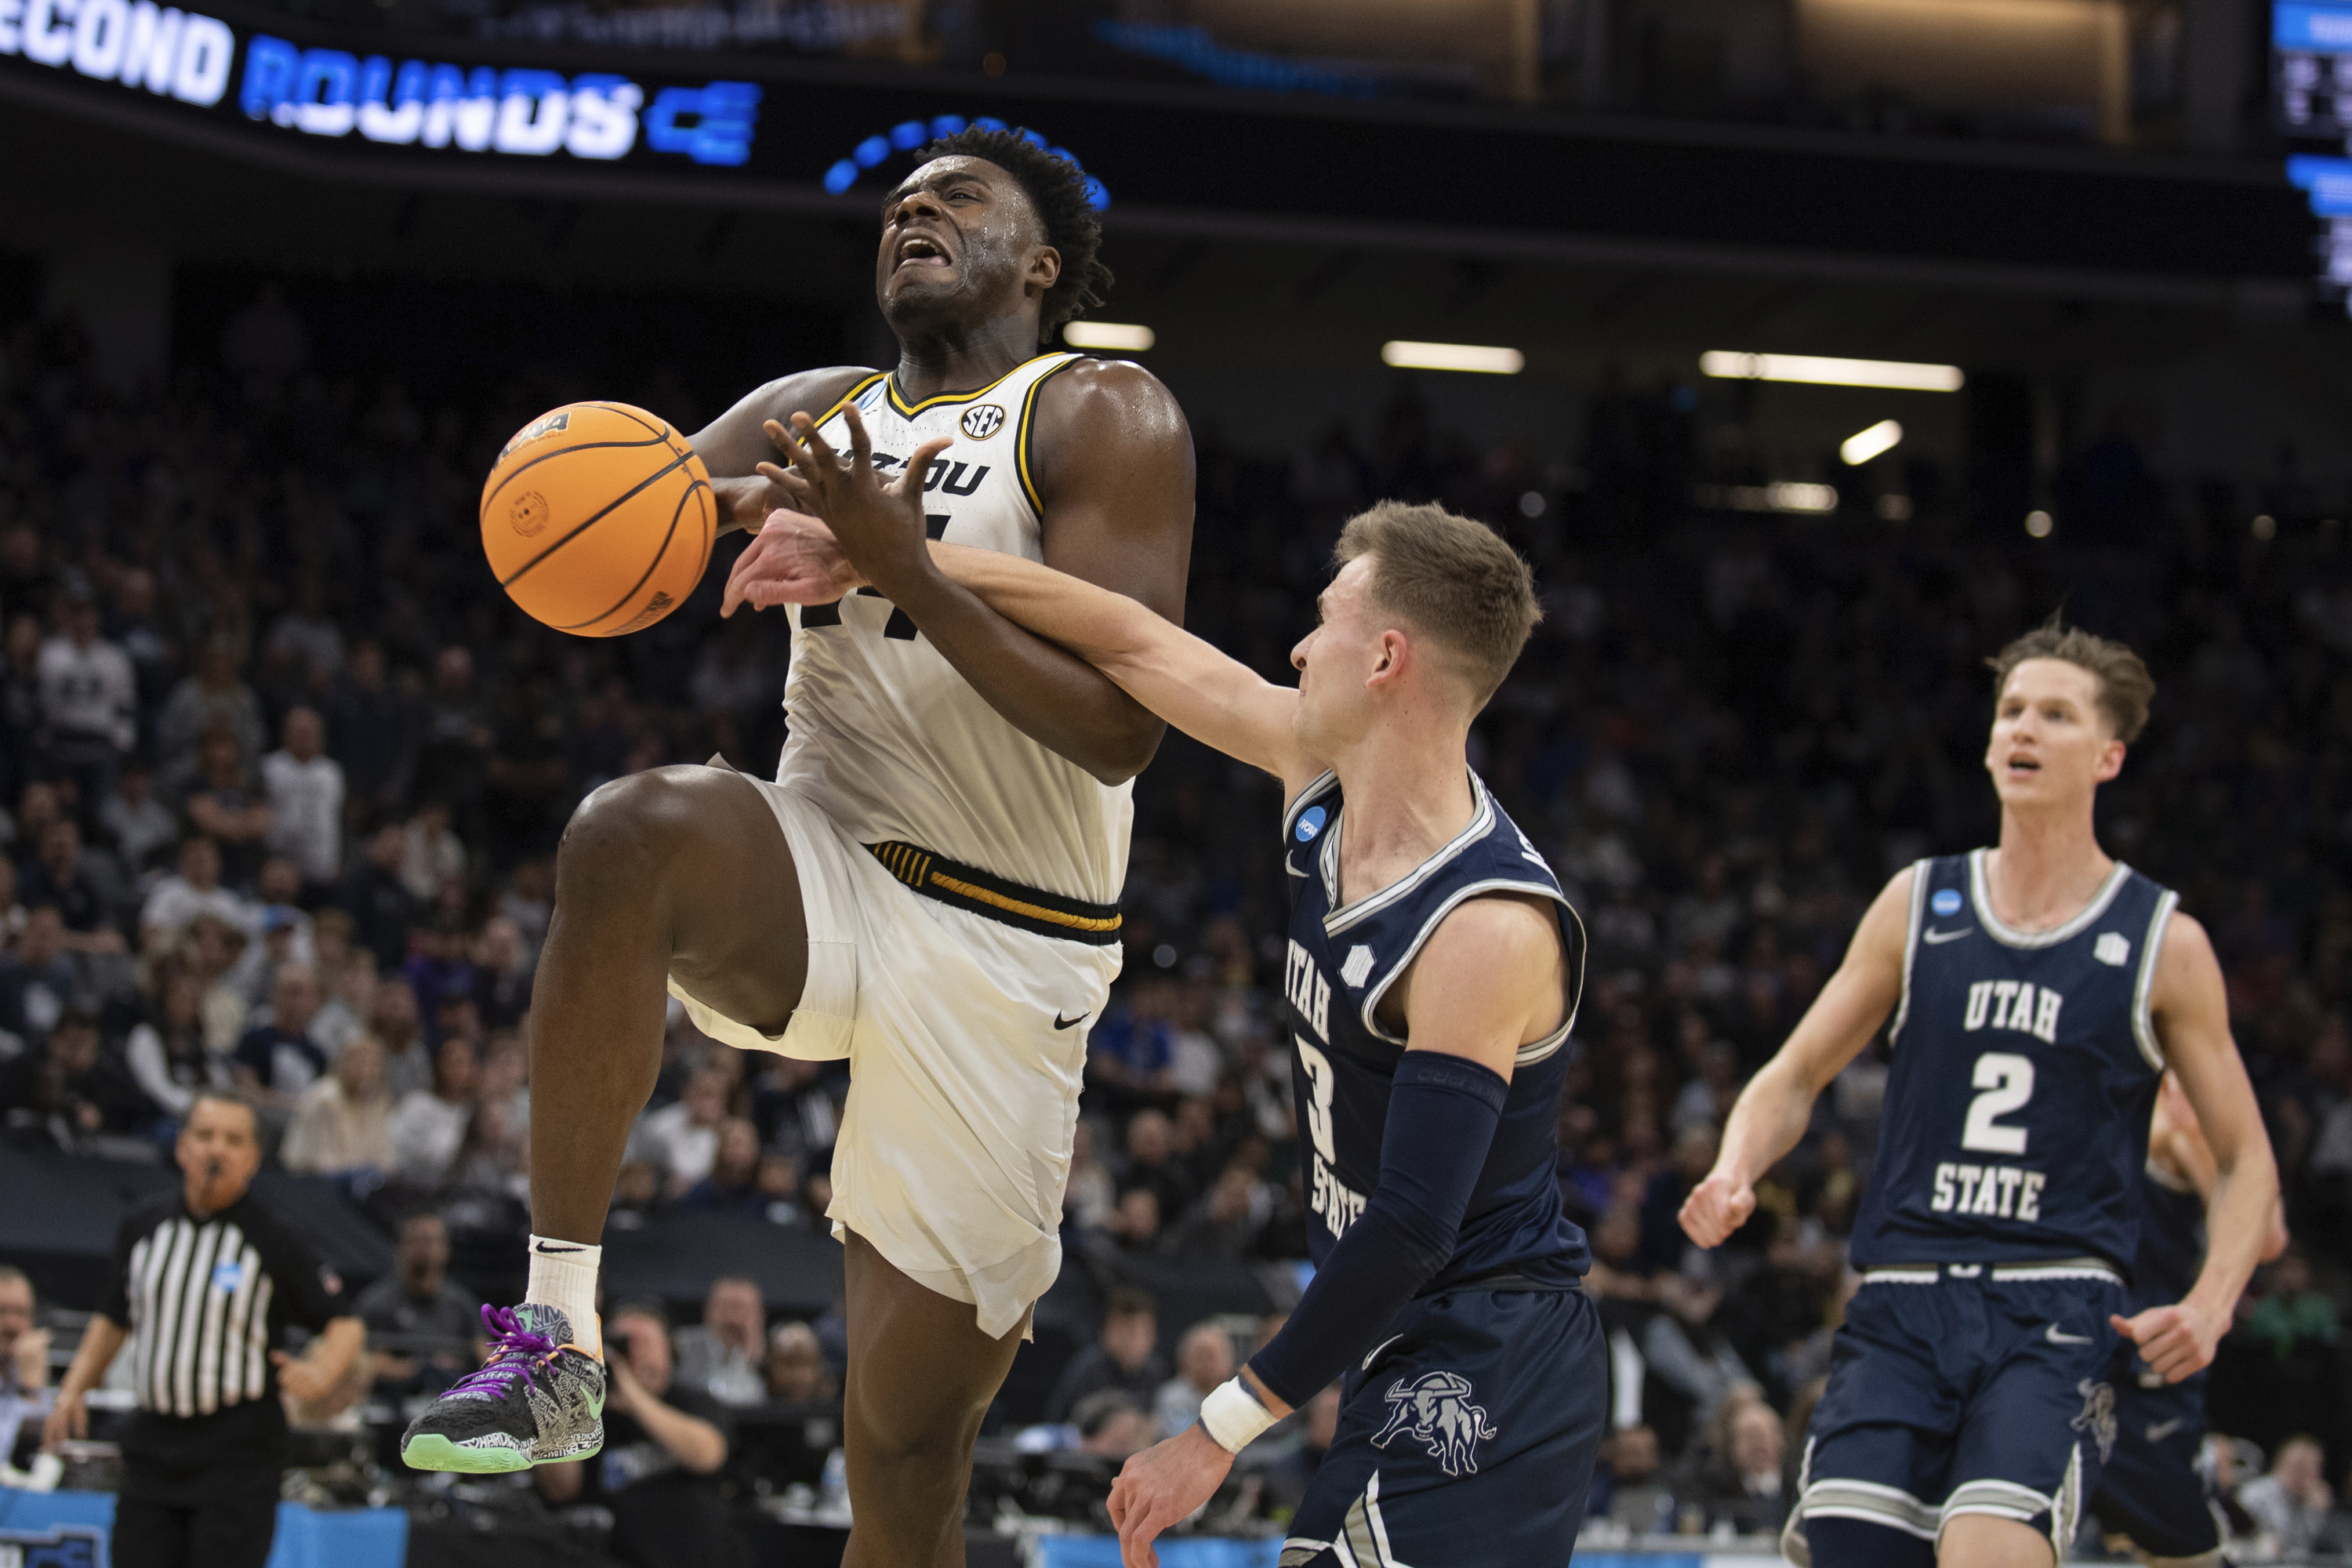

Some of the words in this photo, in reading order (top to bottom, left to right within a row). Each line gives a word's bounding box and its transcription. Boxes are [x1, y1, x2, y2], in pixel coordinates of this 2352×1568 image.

[238, 33, 644, 160] ROUNDS
[962, 405, 1004, 437] SEC
[1963, 980, 2063, 1046] UTAH
[1295, 1032, 1336, 1166] 3
[1962, 1051, 2036, 1156] 2
[1931, 1162, 2046, 1223] STATE
